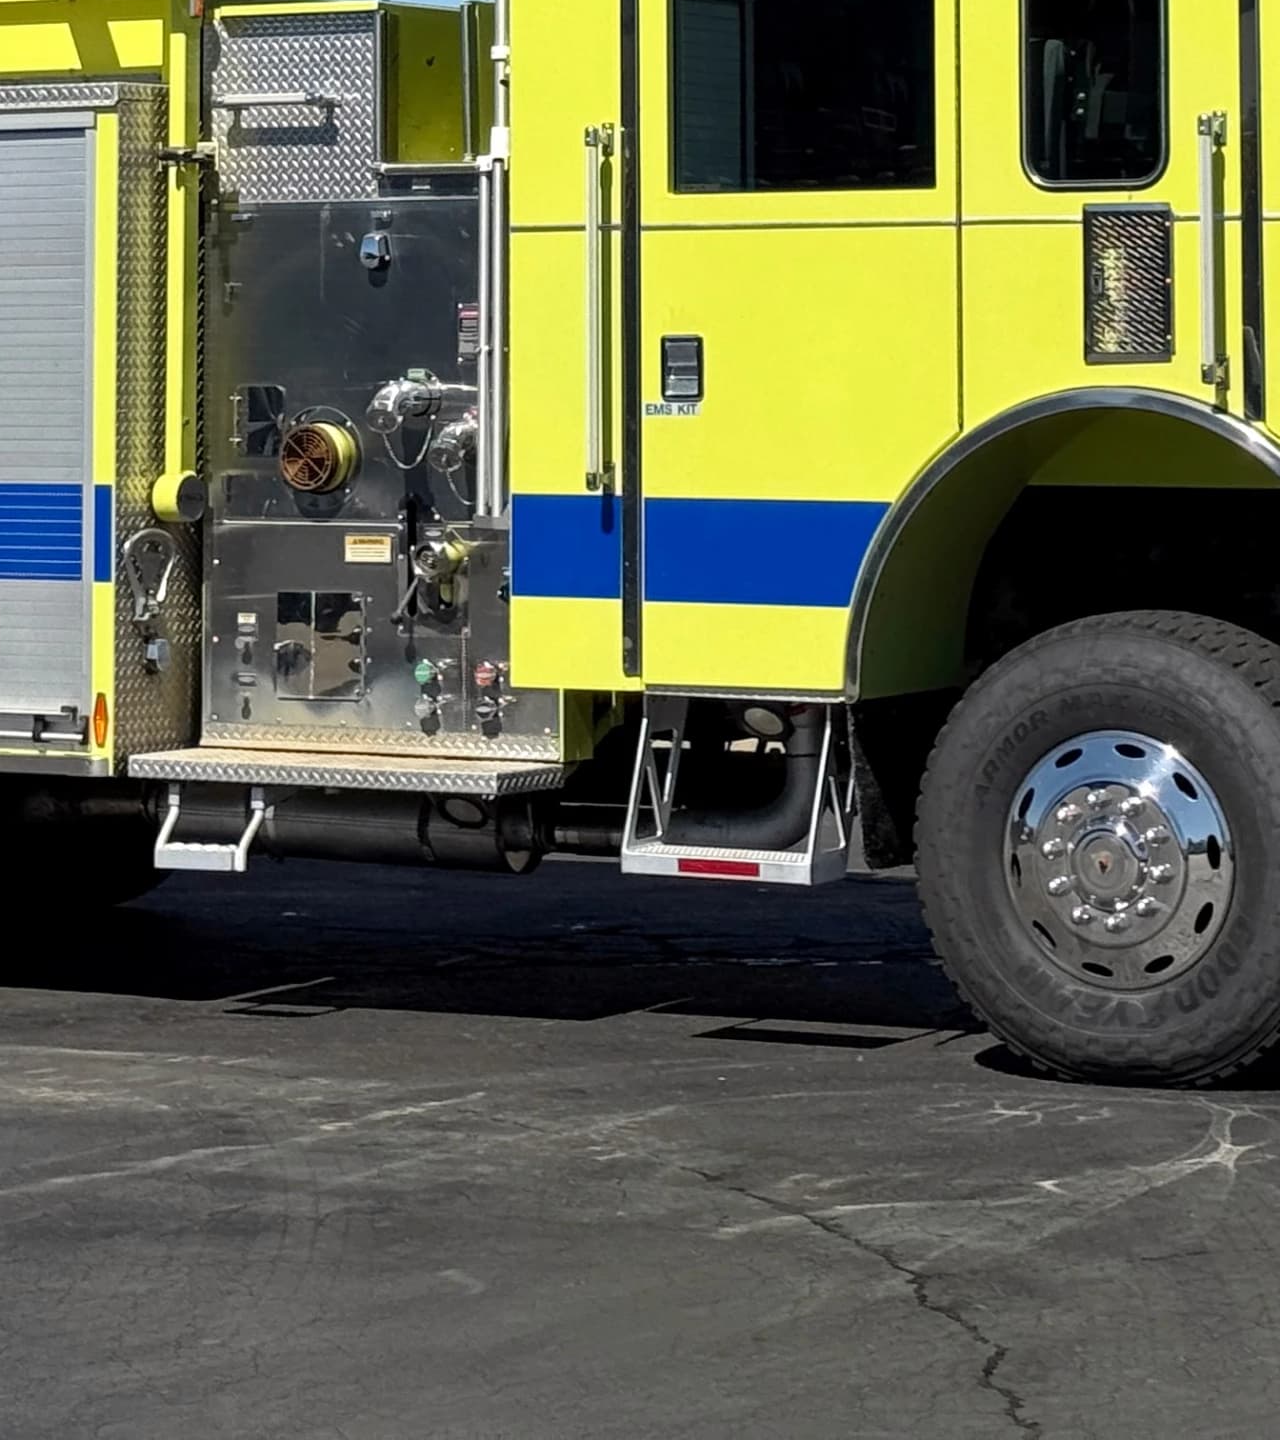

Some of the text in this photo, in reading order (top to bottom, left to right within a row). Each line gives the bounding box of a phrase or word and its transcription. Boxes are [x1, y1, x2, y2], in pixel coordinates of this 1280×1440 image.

[645, 404, 698, 415] EMS KIT
[974, 708, 1050, 806] ARMOR
